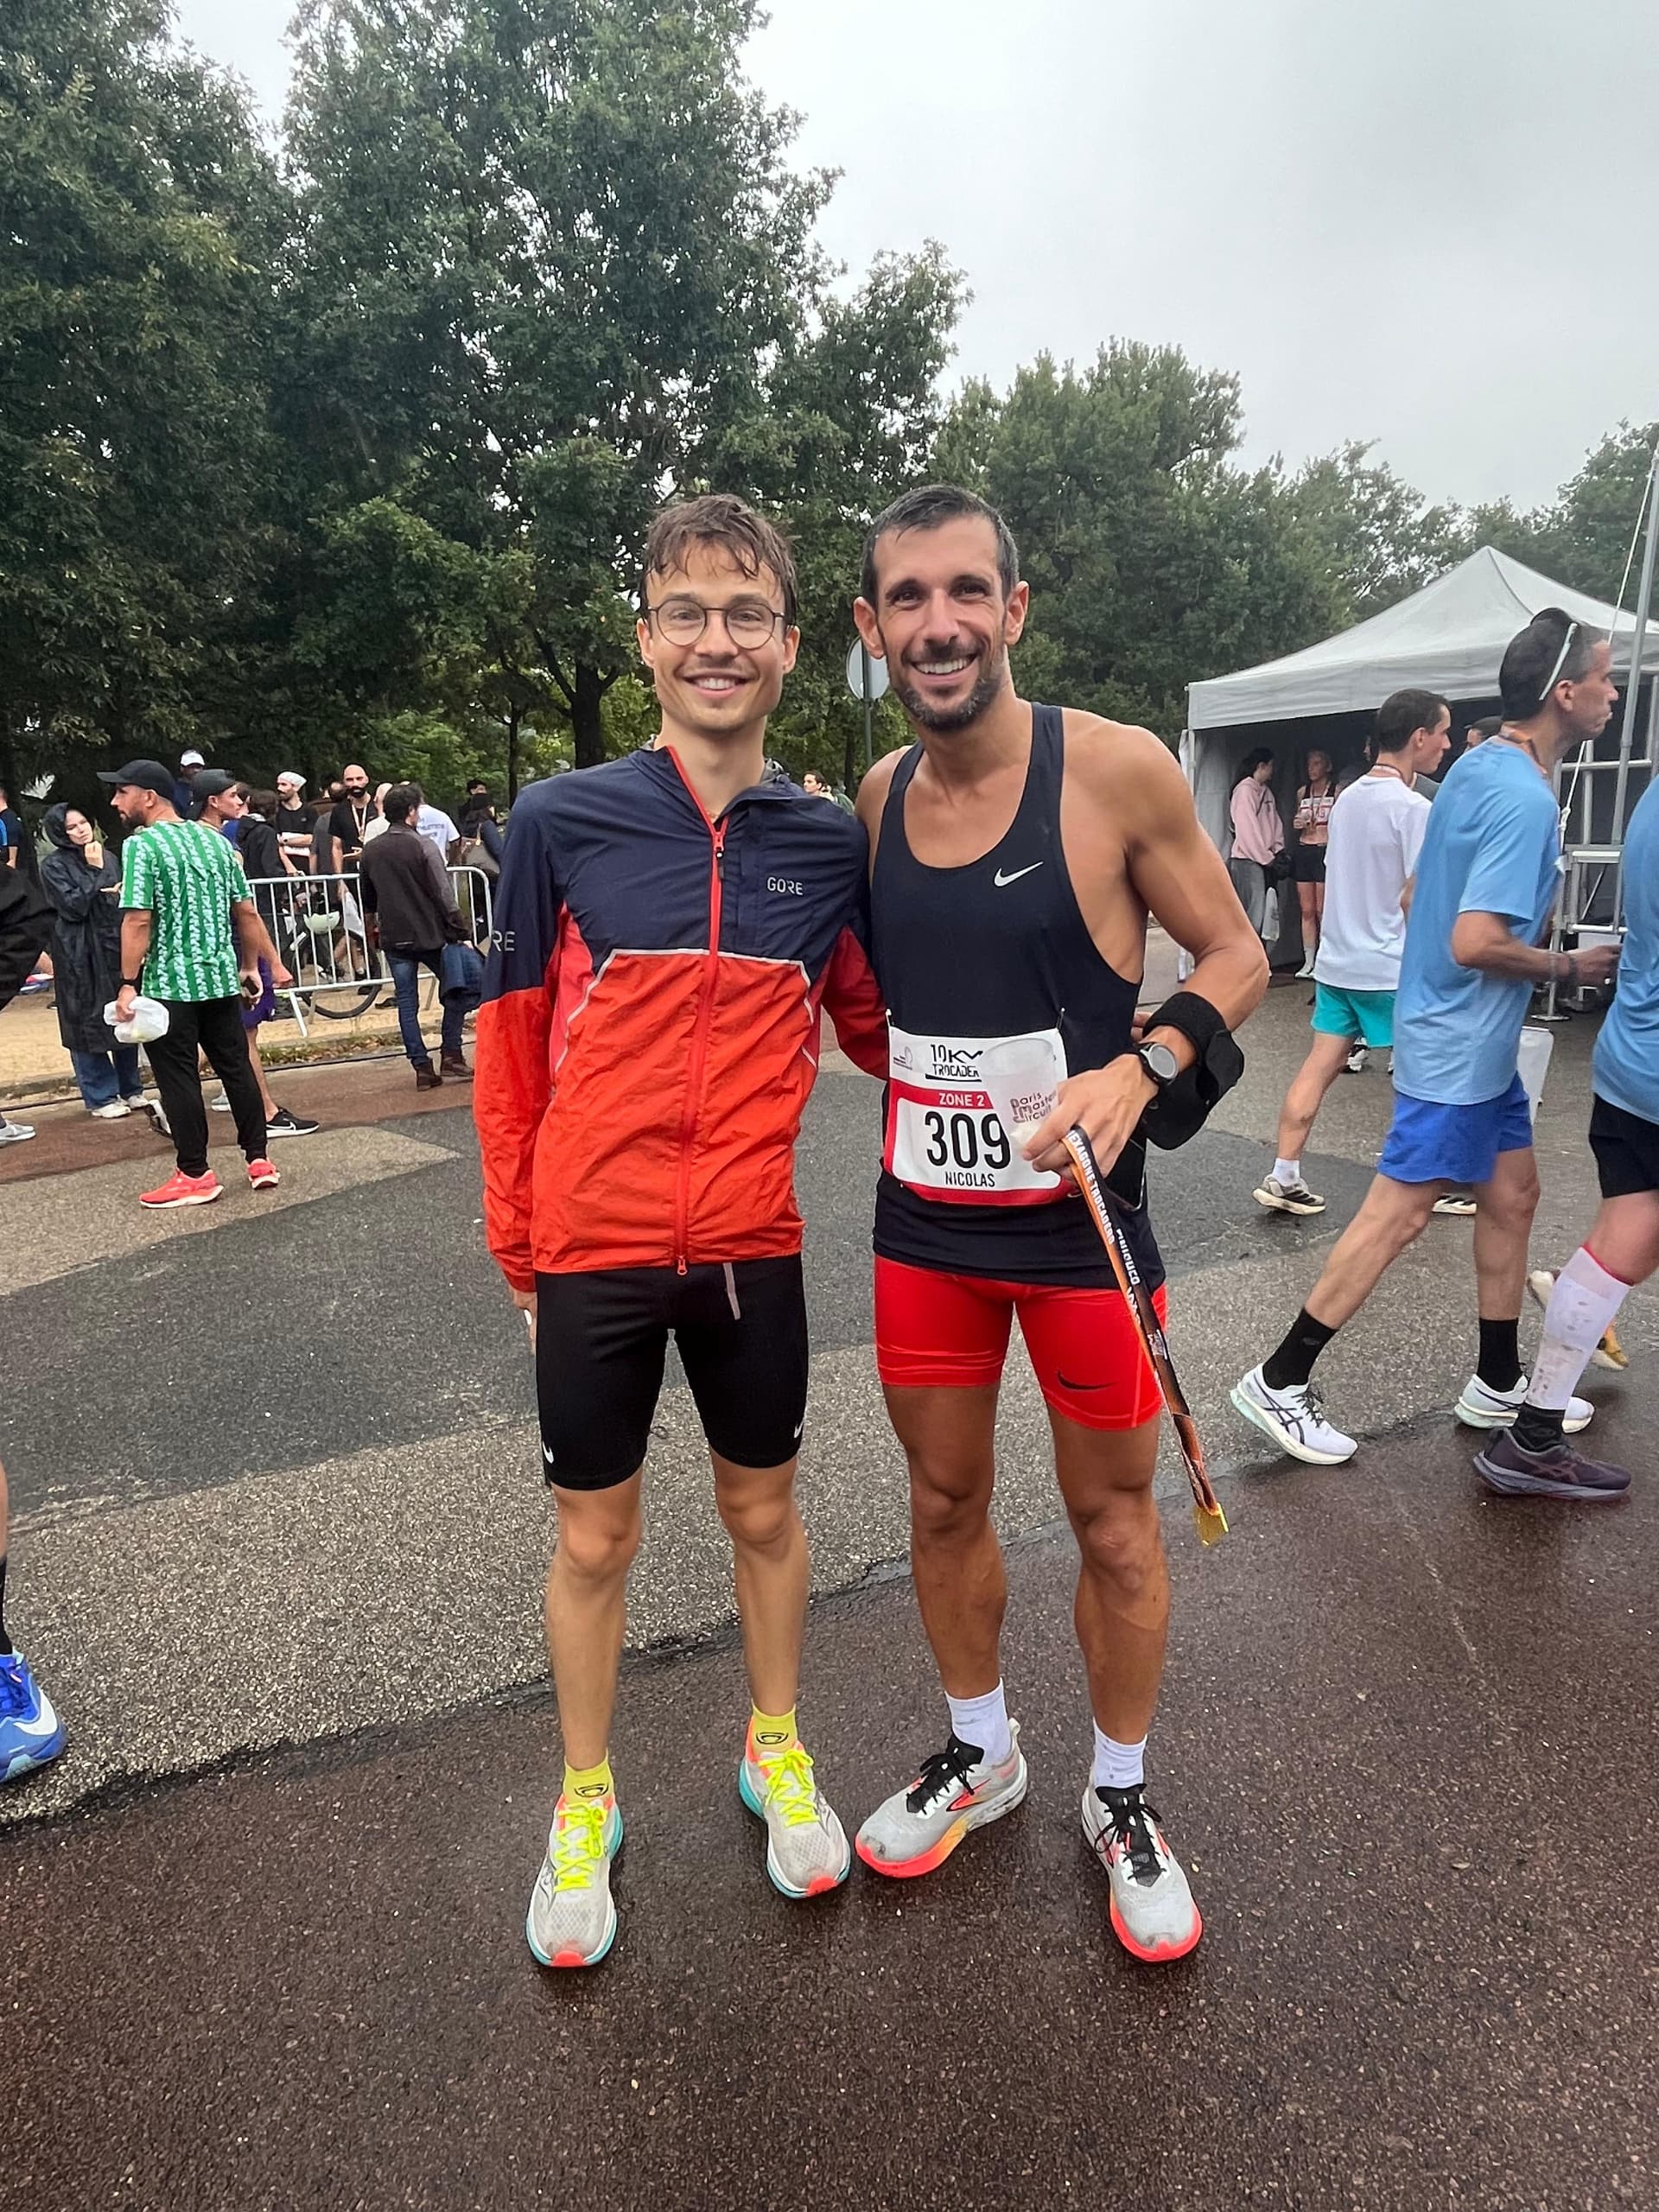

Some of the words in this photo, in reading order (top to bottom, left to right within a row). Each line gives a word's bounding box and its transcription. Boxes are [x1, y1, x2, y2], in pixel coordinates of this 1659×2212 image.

[767, 876, 804, 896] GORE
[492, 930, 516, 952] RE
[938, 1092, 973, 1107] ZONE
[976, 1094, 985, 1107] 2
[925, 1110, 1011, 1169] 309
[944, 1171, 995, 1187] NICOLAS
